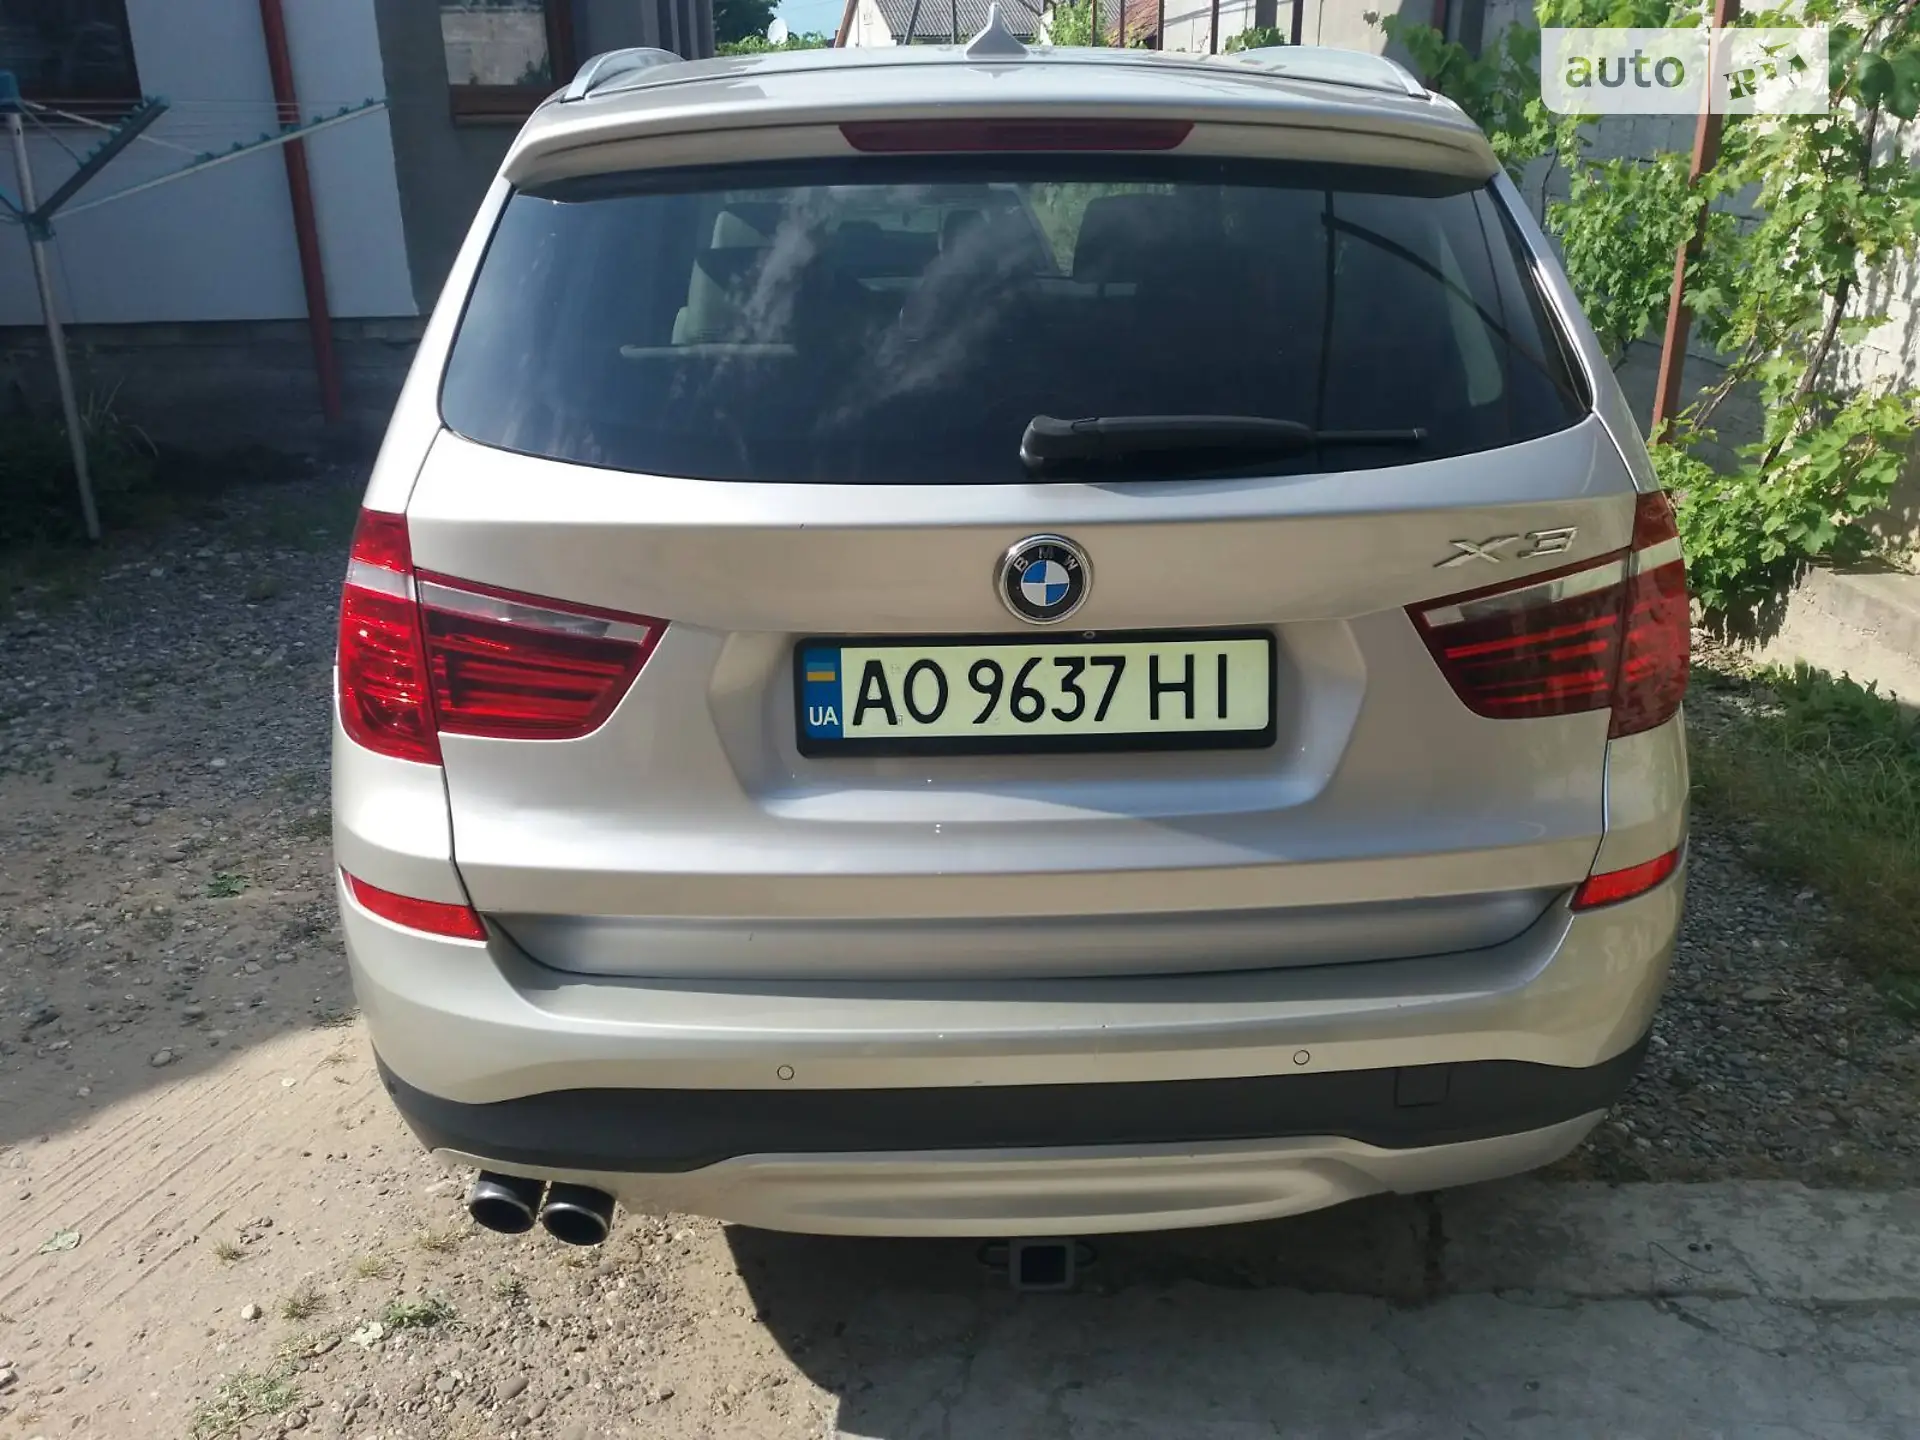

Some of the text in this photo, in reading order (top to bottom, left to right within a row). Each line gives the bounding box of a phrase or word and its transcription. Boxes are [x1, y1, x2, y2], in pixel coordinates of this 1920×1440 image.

[1013, 547, 1079, 572] BMW
[1433, 526, 1578, 568] X3
[852, 653, 1228, 726] AO 9637 HI
[809, 706, 839, 726] UA
